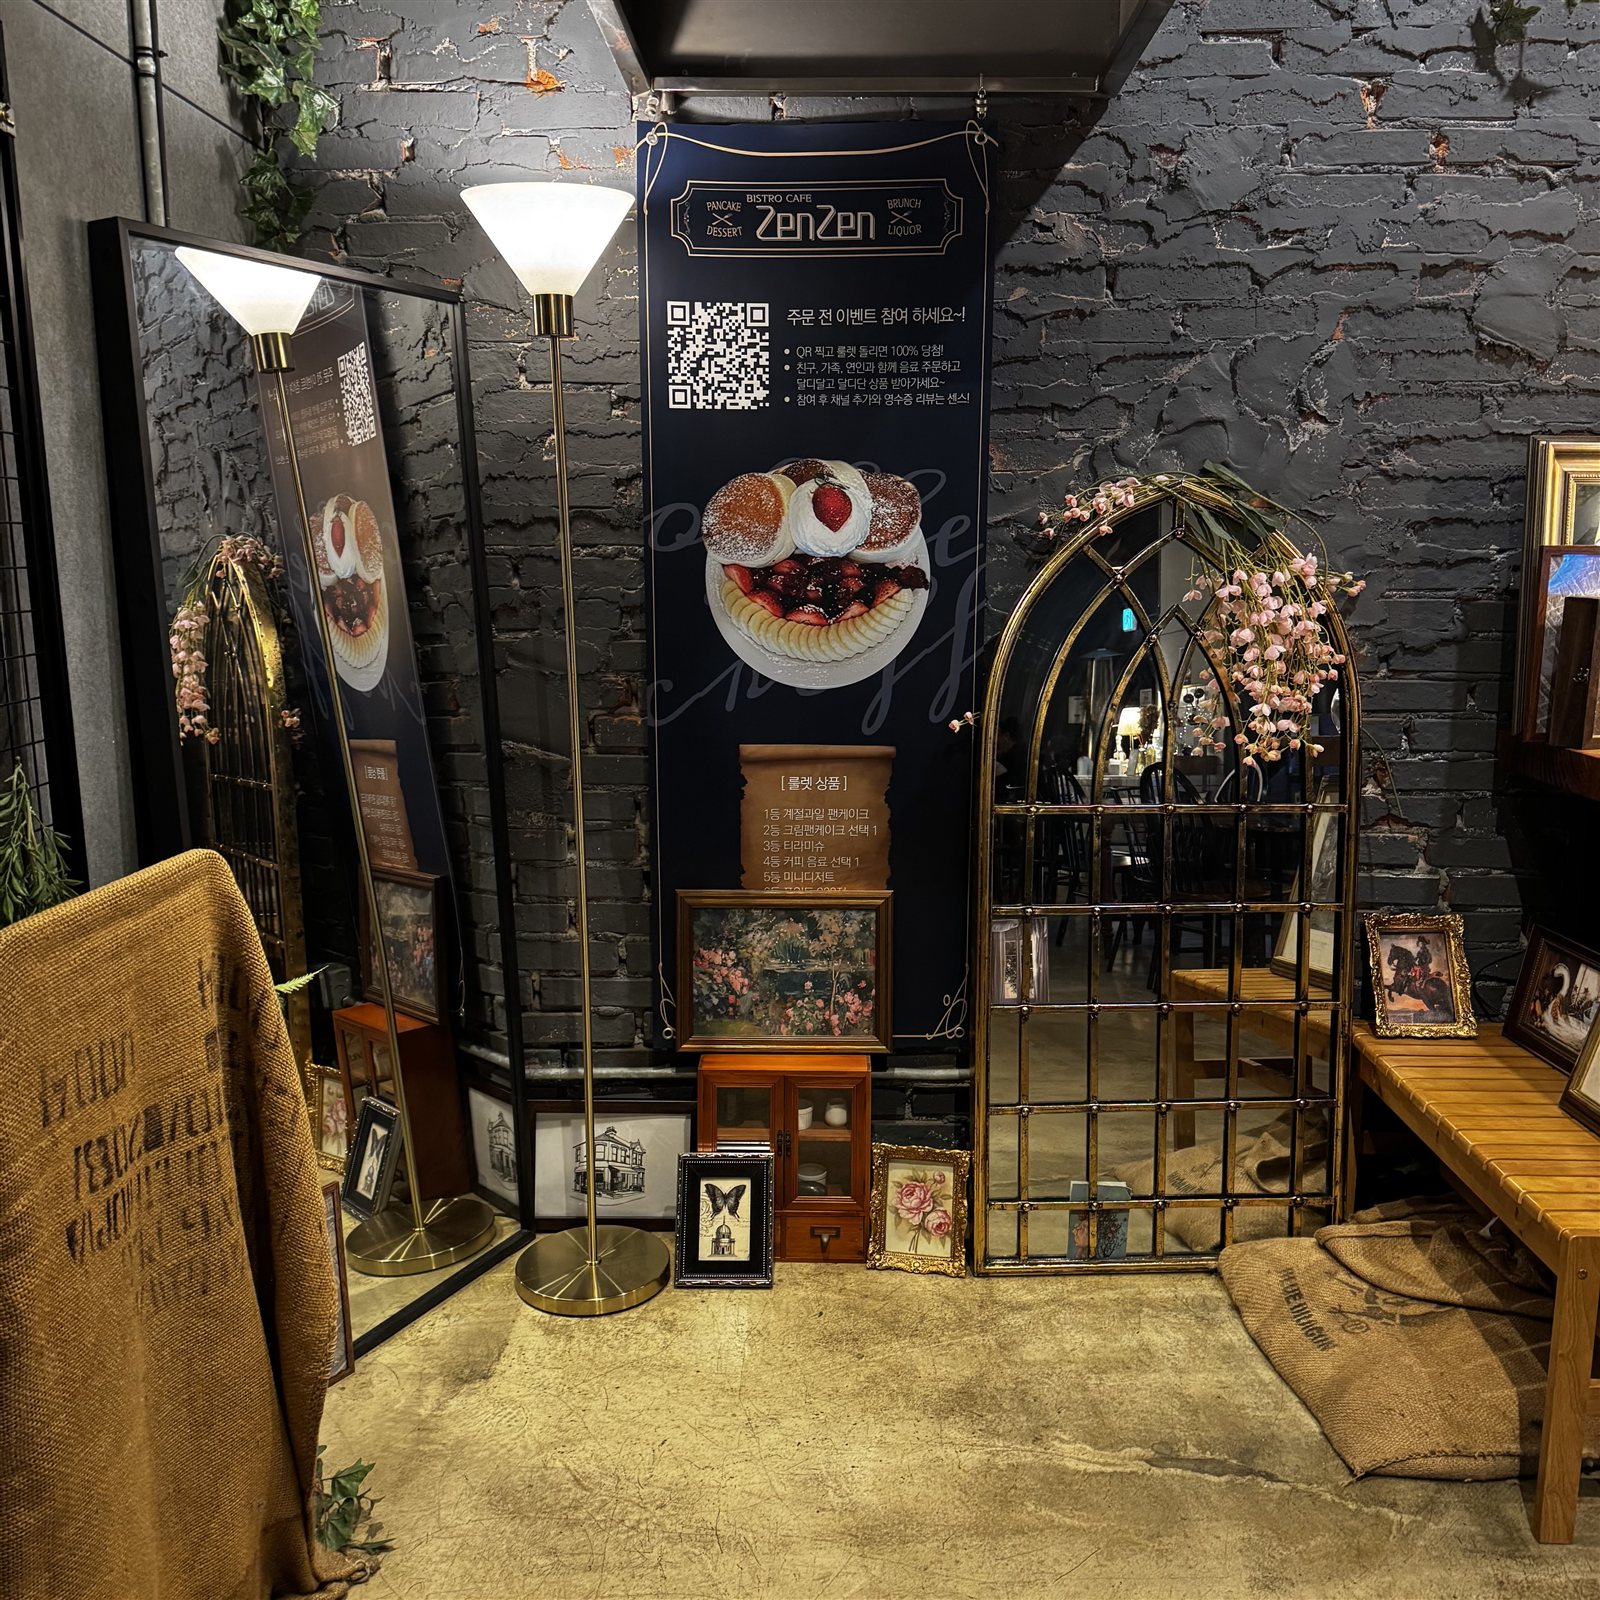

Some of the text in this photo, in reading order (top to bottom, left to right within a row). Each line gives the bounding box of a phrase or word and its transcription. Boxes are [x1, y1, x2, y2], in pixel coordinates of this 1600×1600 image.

[746, 193, 812, 203] BISTRO CAFE
[887, 198, 922, 209] BRUNCH
[706, 200, 742, 212] PANCAKE
[755, 204, 876, 242] ZenZen
[706, 225, 743, 238] DESSERT
[887, 224, 923, 236] LIQUOR
[786, 308, 816, 326] 주문
[818, 308, 833, 326] 전
[836, 308, 878, 326] 이벤트
[880, 307, 910, 325] 참여
[796, 344, 944, 359] QR 찍고 룰렛 돌리면 100% 당첨!
[796, 360, 961, 374] 친구, 가족, 연인과 함께 음료 주문하고
[796, 378, 835, 390] 달디달고
[837, 378, 867, 390] 달디단
[868, 377, 889, 390] 상품
[796, 394, 816, 406] 참여
[818, 394, 829, 406] 후
[830, 394, 850, 406] 채널
[852, 393, 882, 406] 추가와
[884, 393, 914, 406] 영수증
[916, 393, 945, 405] 리뷰는
[763, 808, 870, 820] 1등 계절과일 팬케이크
[763, 825, 877, 837] 2등 크림팬케이크 선택 1
[763, 840, 825, 853] 3등 티라미슈
[763, 856, 859, 868] 4등 커피 음료 선택 1
[763, 871, 835, 883] 5등 미니디저트
